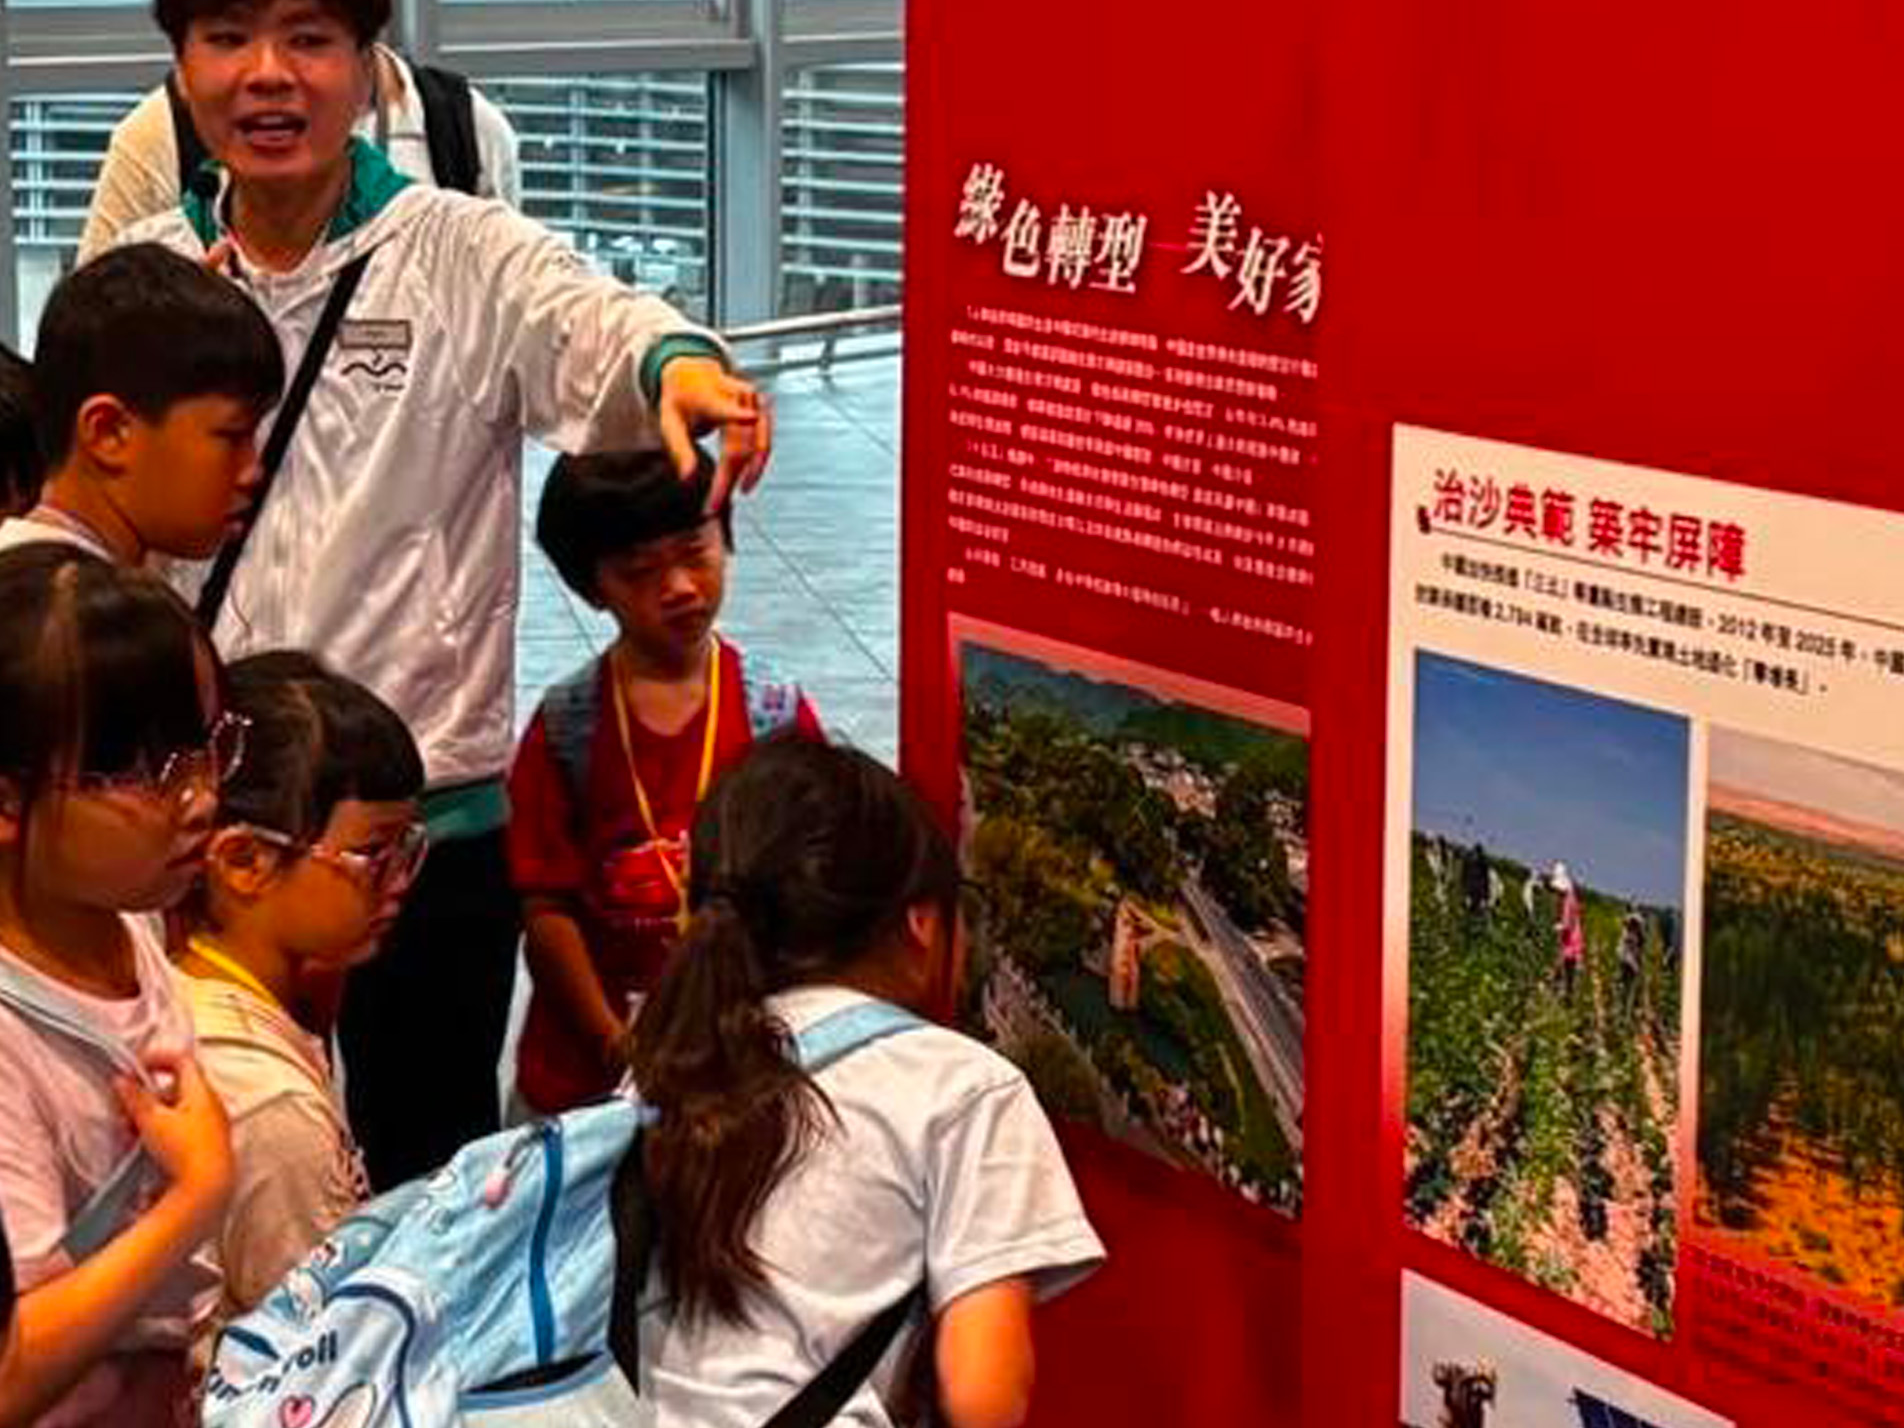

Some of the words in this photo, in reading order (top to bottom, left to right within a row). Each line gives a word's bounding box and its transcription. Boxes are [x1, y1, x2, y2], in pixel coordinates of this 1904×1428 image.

[954, 163, 1146, 294] 綠色轉型
[1433, 470, 1576, 548] 治沙典範
[1588, 497, 1746, 582] 築牢屏障
